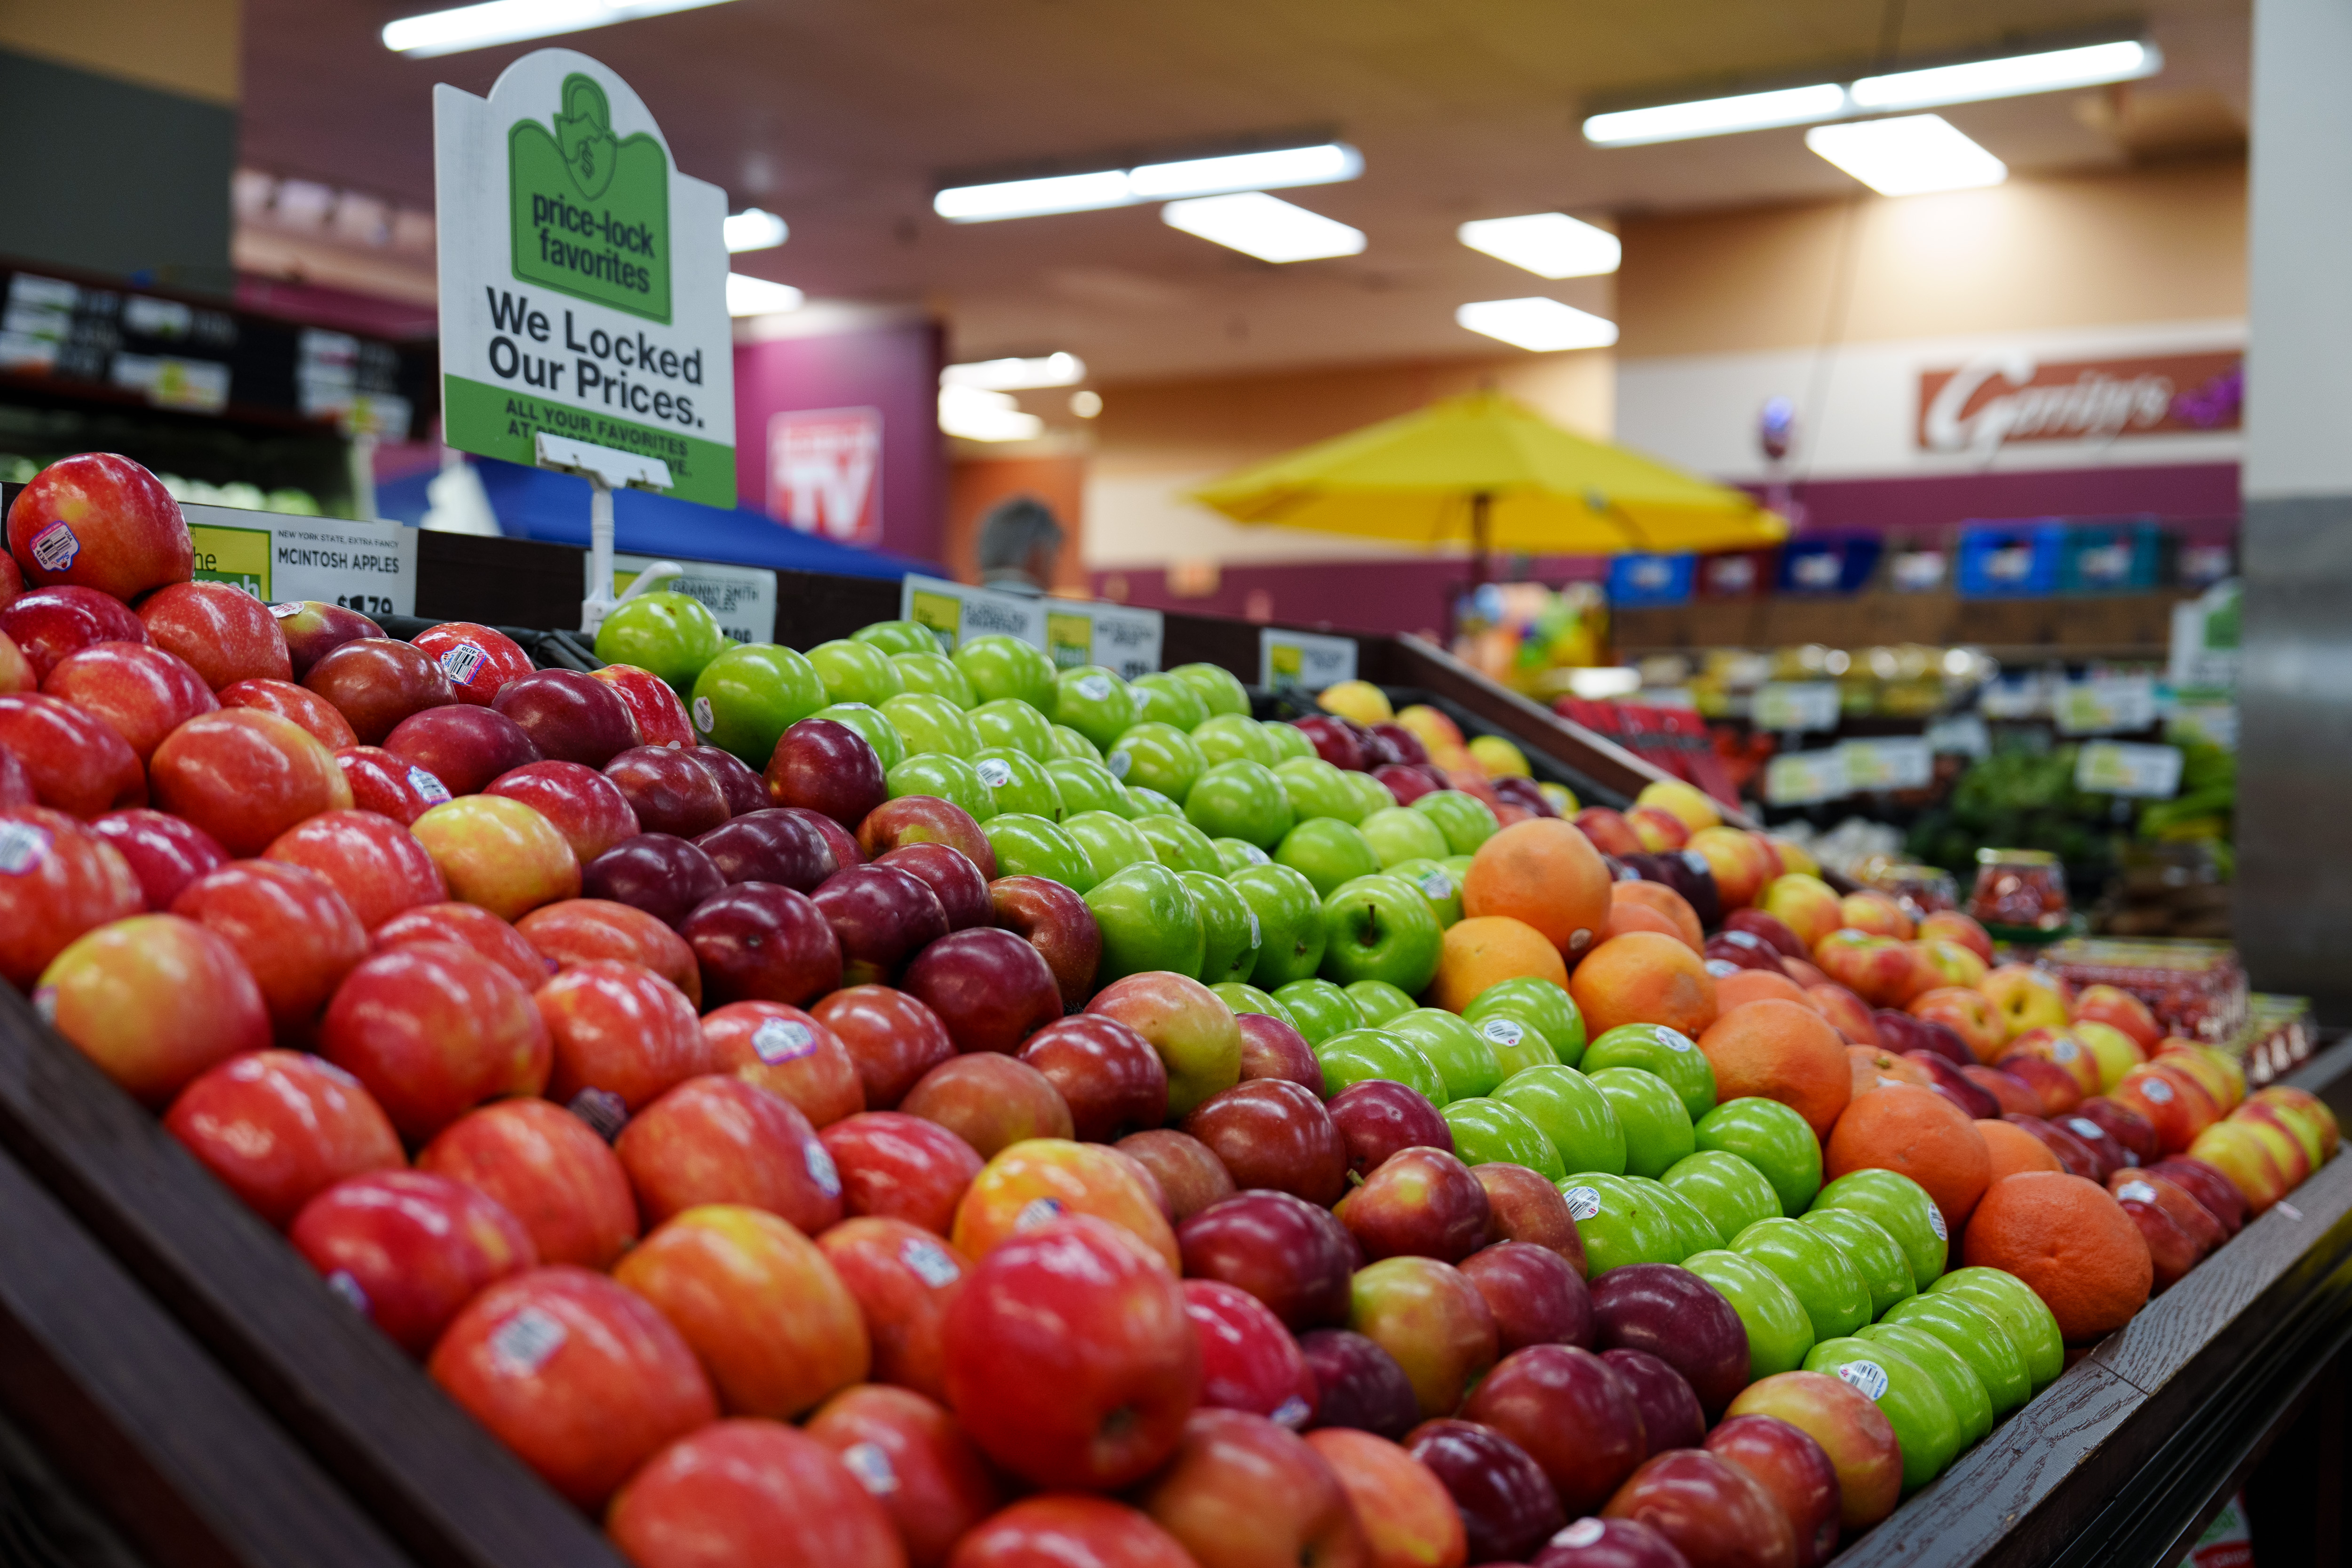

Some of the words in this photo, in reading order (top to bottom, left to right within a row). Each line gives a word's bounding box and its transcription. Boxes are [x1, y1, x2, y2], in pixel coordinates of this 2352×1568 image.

[533, 191, 655, 259] price-lock
[540, 228, 651, 295] favorites
[486, 286, 551, 343] We
[564, 309, 703, 386] Locked
[488, 335, 565, 391] Our
[577, 358, 705, 429] Prices.
[506, 398, 539, 421] ALL
[543, 406, 592, 433] YOUR
[596, 422, 688, 456] FAVORITES
[508, 419, 532, 438] AT
[36, 550, 48, 565] 4130
[193, 546, 217, 571] he
[278, 529, 296, 539] NEW
[298, 531, 319, 541] YORK
[349, 536, 373, 545] EXTRA
[375, 538, 399, 548] FANCY
[278, 547, 348, 569] MCINTOSH
[353, 553, 399, 573] APPLES
